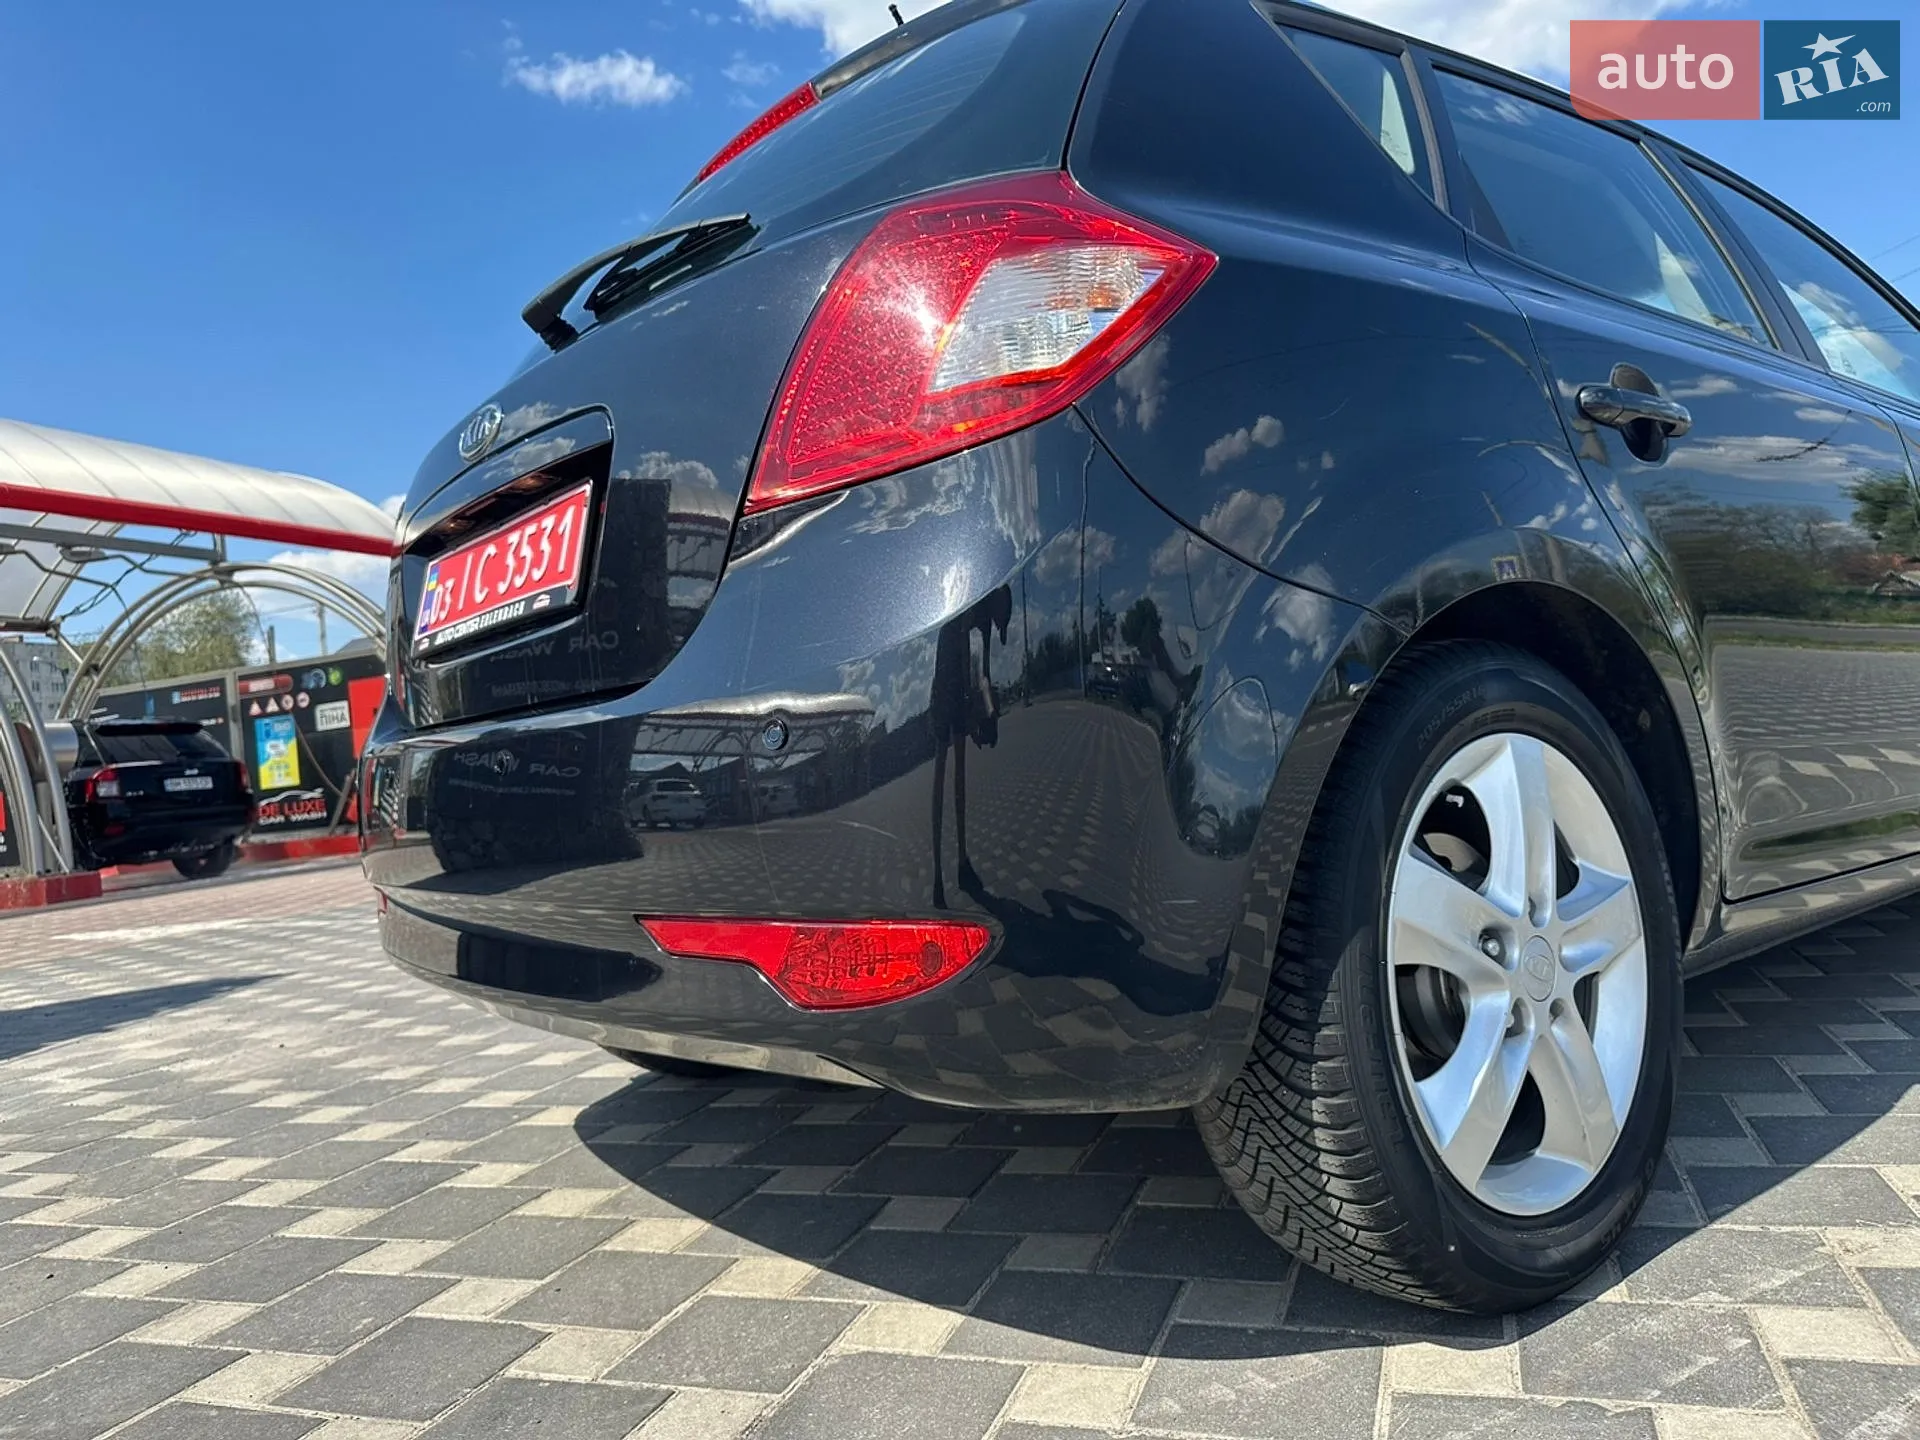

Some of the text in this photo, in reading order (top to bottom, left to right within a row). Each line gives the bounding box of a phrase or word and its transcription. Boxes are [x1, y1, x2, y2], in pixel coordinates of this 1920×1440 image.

[430, 578, 455, 624] 03
[497, 504, 576, 595] 3531
[258, 799, 326, 817] DE LUXE
[258, 811, 327, 826] CAR WASH
